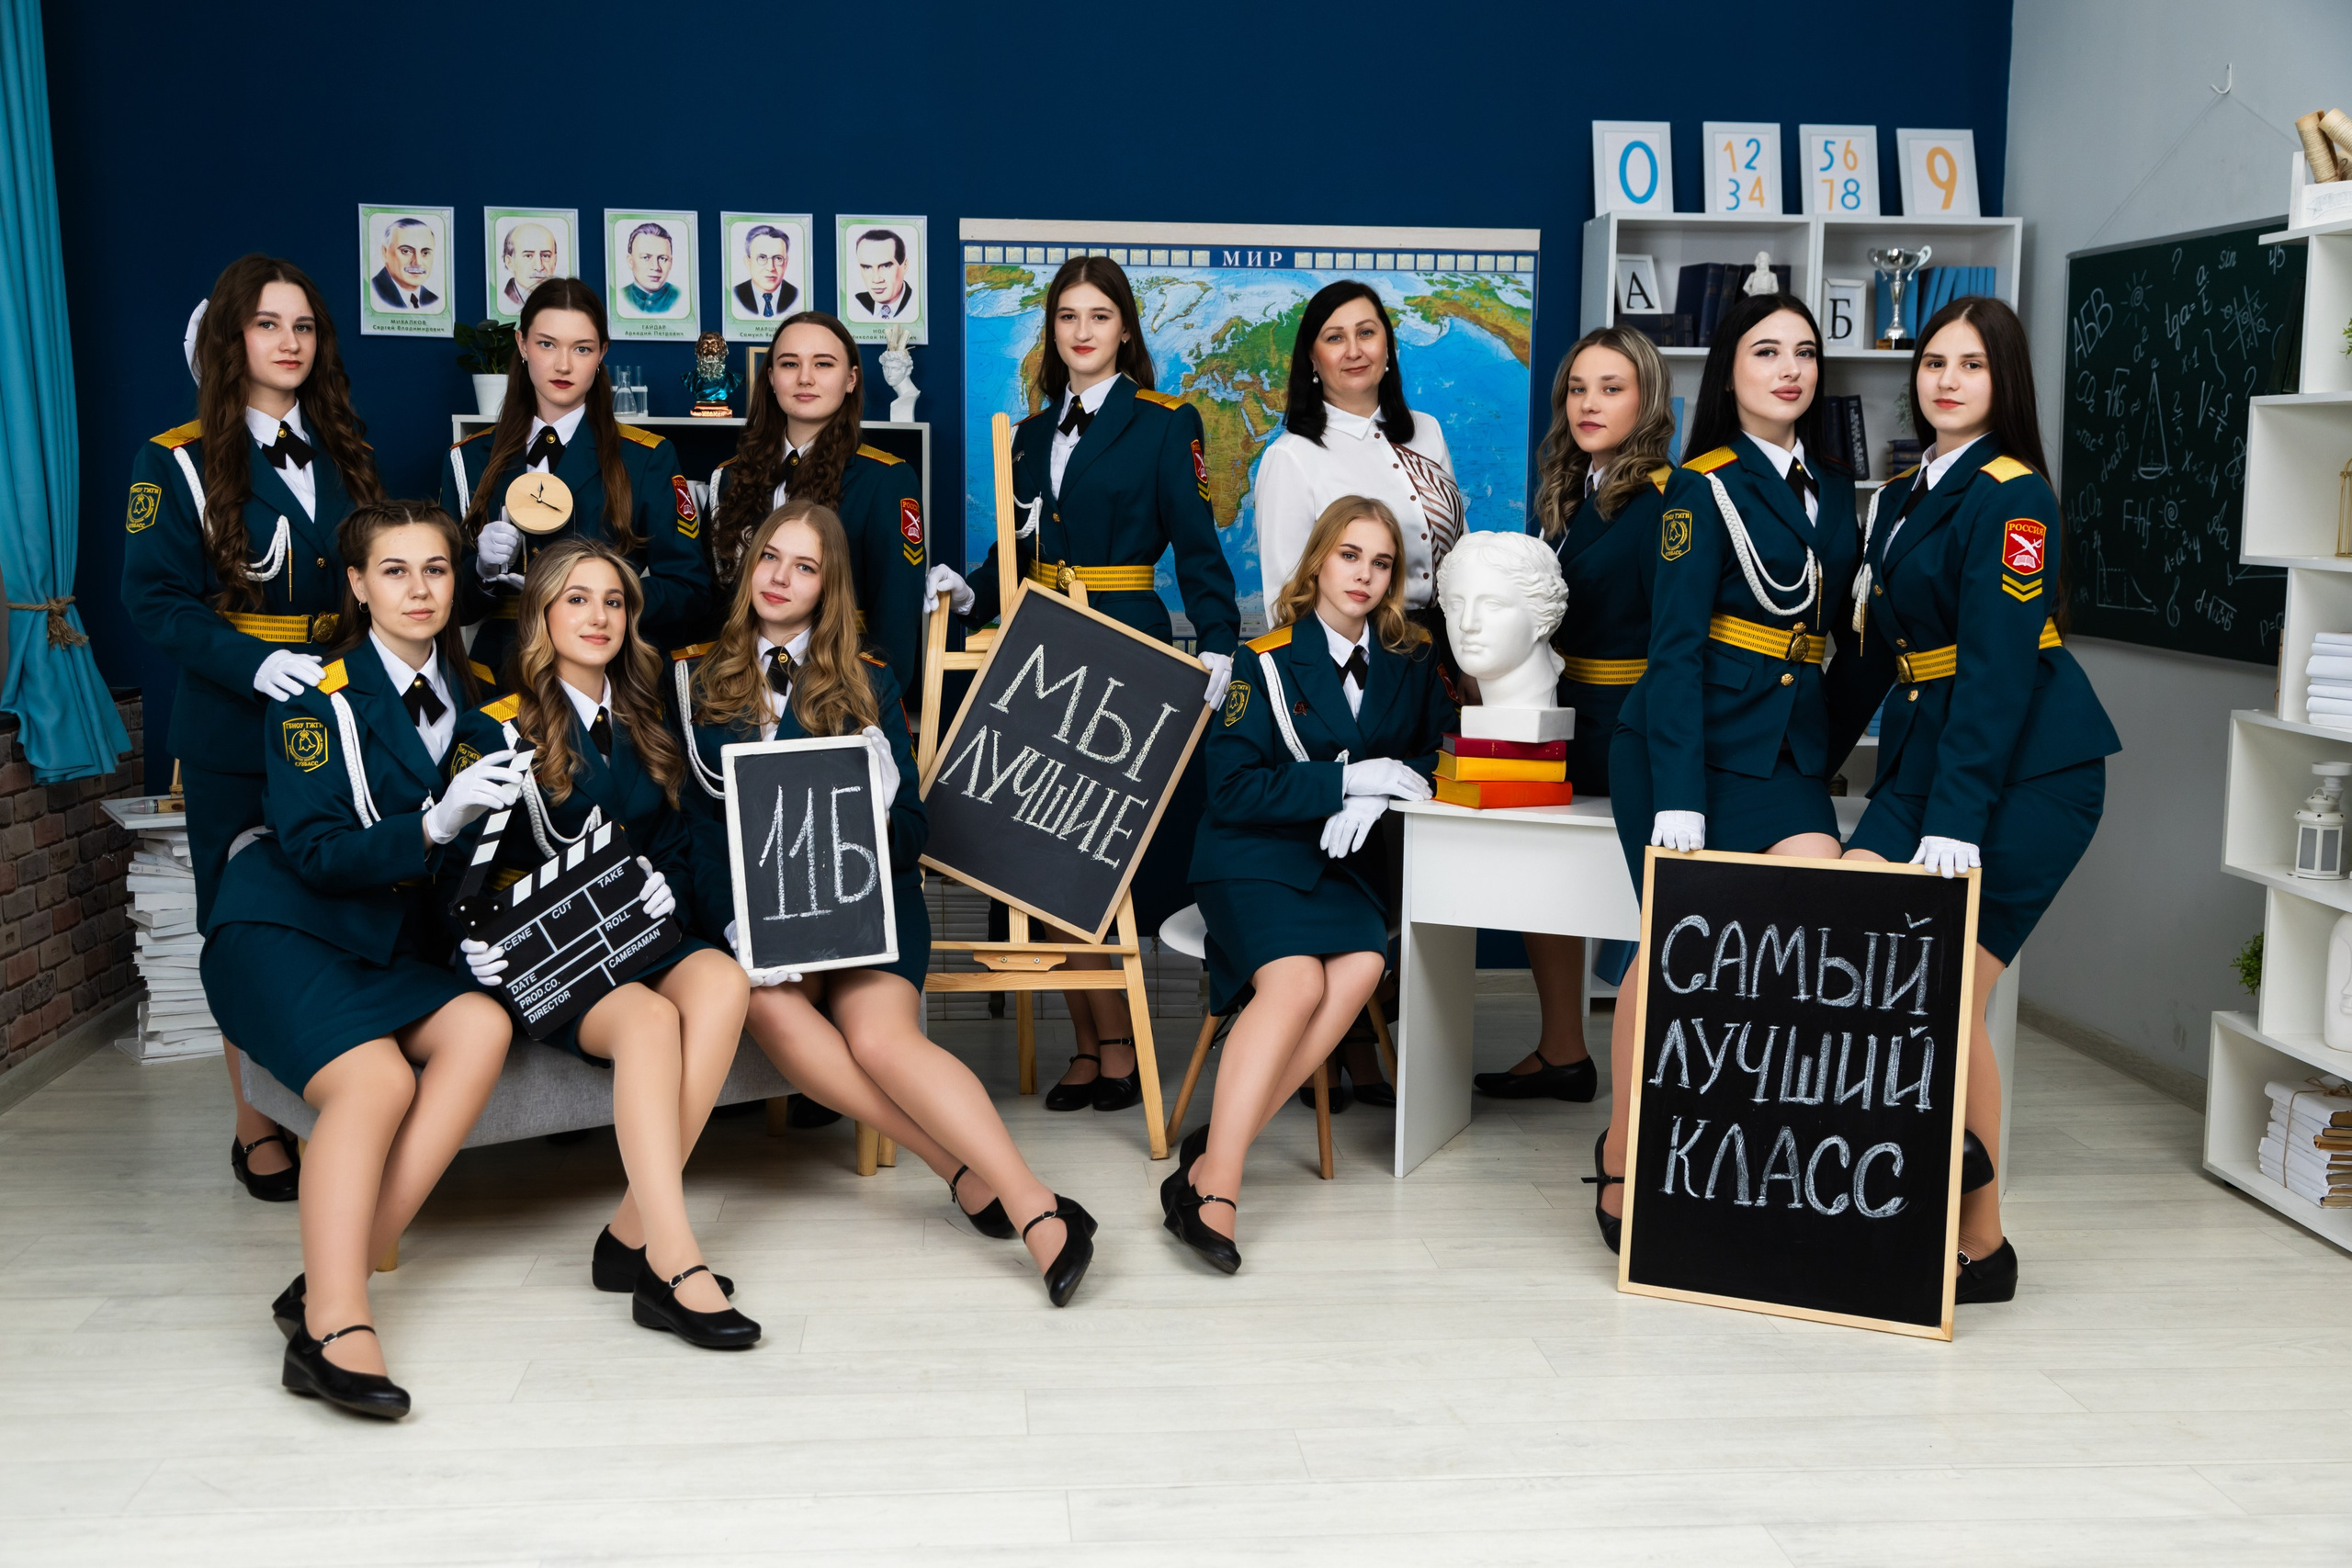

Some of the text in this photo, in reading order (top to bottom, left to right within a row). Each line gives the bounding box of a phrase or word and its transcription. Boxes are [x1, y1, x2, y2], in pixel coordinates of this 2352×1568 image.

[1619, 141, 1658, 204] 0
[1926, 146, 1958, 210] 9
[1222, 250, 1283, 267] МИР
[2218, 246, 2236, 269] sin
[1827, 298, 1853, 340] Б
[2074, 288, 2113, 367] АБВ
[2008, 523, 2044, 536] РОССИЯ
[989, 643, 1181, 782] МЫ
[937, 724, 1148, 870] ЛУЧШИЕ
[758, 784, 878, 922] 11Б
[596, 866, 625, 888] TAKE
[551, 899, 572, 919] CUT
[605, 910, 631, 931] ROLL
[607, 928, 661, 969] CAMERAMAN
[1661, 912, 1936, 1016] САМЫЙ
[511, 972, 537, 996] DATE
[527, 989, 571, 1024] DIRECTOR
[1647, 1018, 1935, 1112] ЛУЧШИЙ
[1659, 1115, 1909, 1218] КЛАСС
